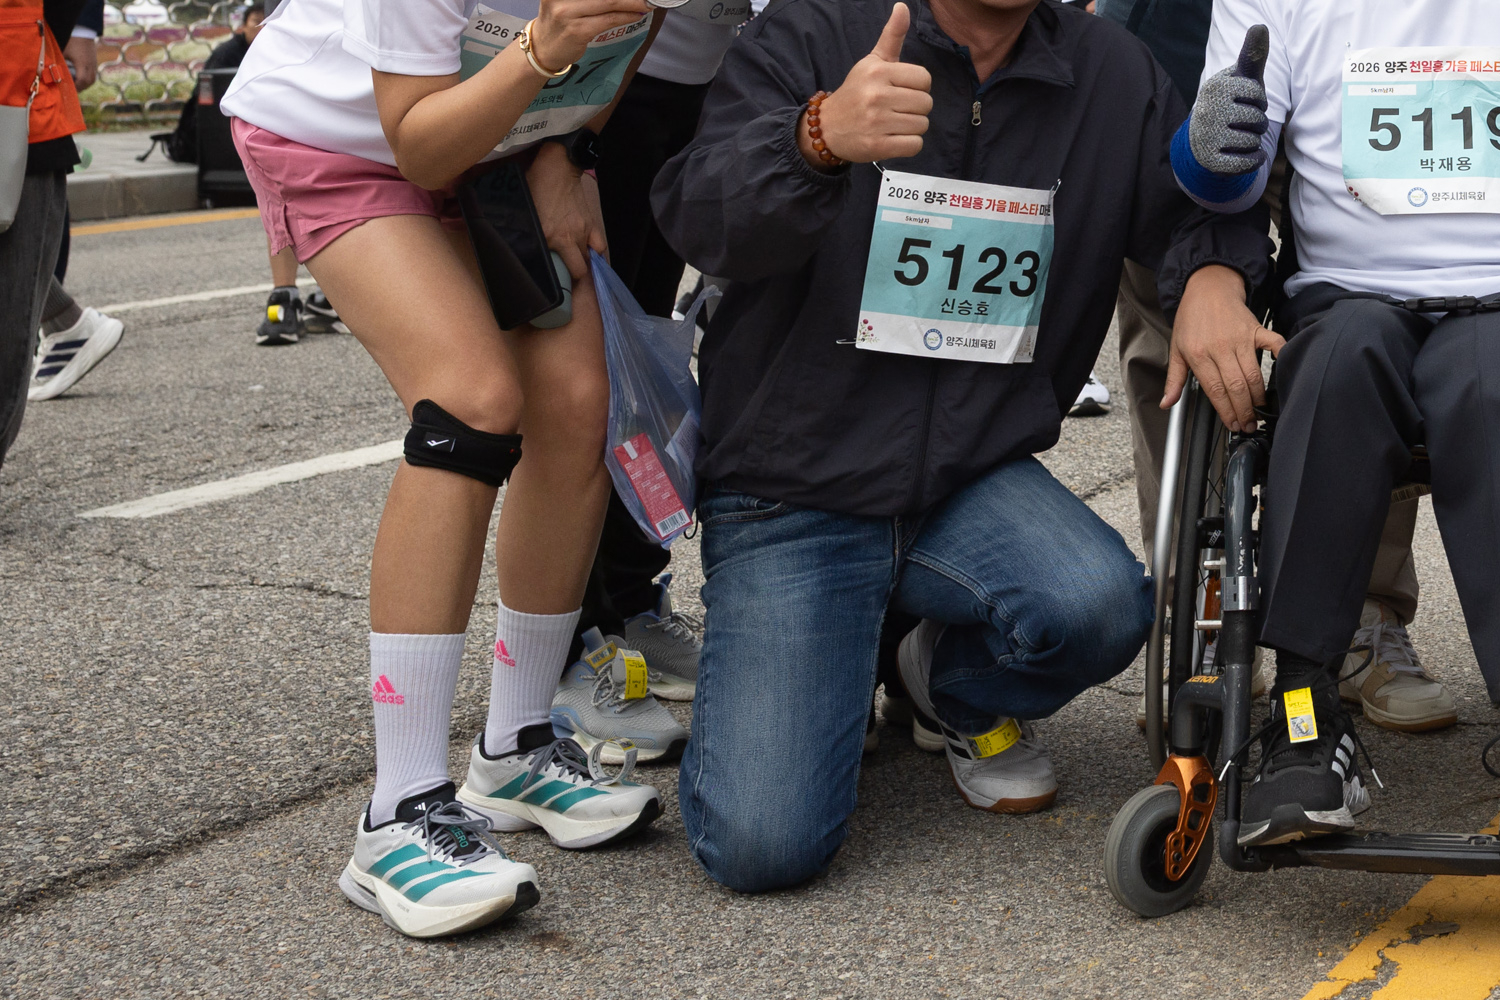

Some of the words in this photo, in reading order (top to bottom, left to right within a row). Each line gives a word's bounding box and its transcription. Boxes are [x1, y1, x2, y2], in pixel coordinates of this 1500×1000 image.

[475, 20, 510, 39] 2026
[1350, 62, 1380, 73] 2026
[1385, 61, 1408, 73] 양주
[1410, 60, 1443, 73] 천일홍
[1445, 60, 1467, 73] 가을
[529, 93, 564, 107] 기도의원
[1420, 156, 1472, 173] 박재용
[887, 186, 919, 201] 2026
[924, 190, 948, 206] 양주
[949, 193, 984, 210] 천일홍
[985, 198, 1007, 214] 가을
[1008, 201, 1039, 217] 페스타
[1431, 190, 1486, 201] 양주시체육회
[904, 215, 930, 225] 5km남자
[893, 237, 1041, 298] 5123
[941, 298, 990, 316] 신승호
[945, 337, 997, 350] 양주시체육회
